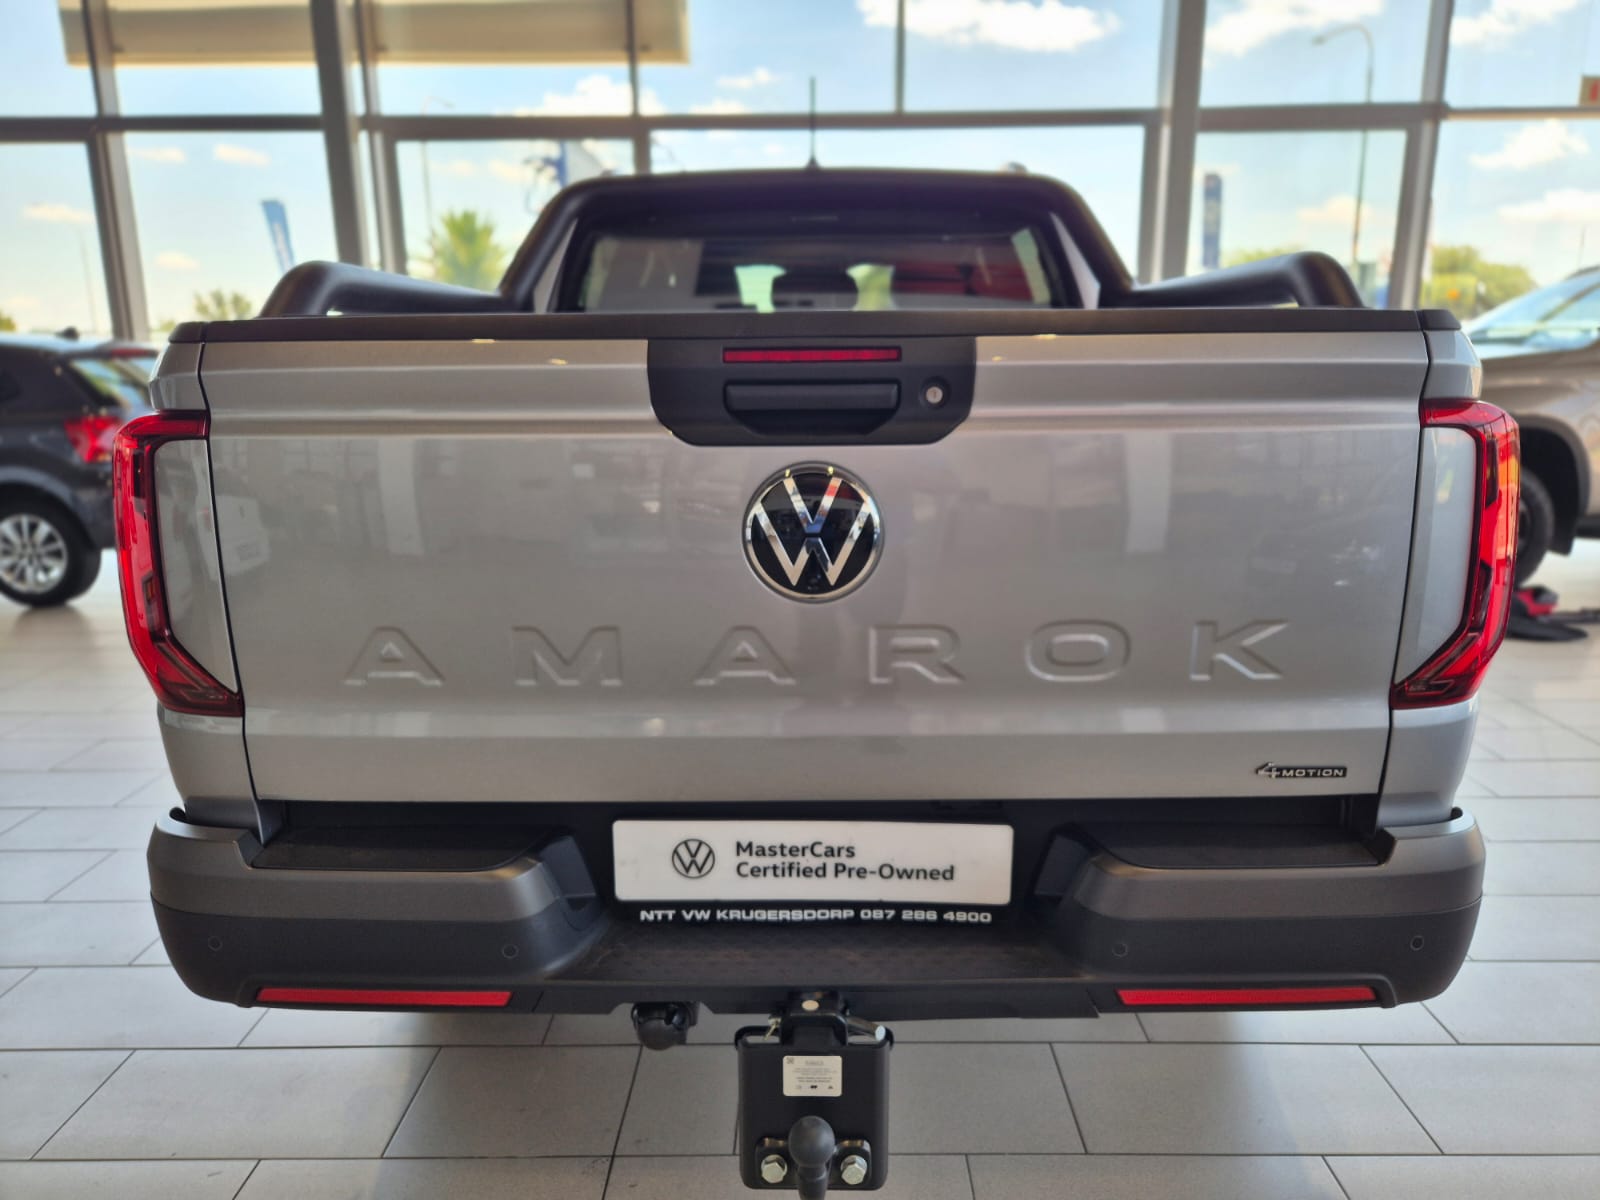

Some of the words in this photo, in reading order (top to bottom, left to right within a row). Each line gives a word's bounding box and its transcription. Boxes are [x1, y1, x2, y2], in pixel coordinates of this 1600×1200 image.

[343, 619, 1289, 687] AMAROK
[736, 841, 856, 858] MasterCars
[736, 862, 827, 878] Certified
[834, 863, 955, 881] Pre-Owned
[640, 909, 676, 921] NTT
[681, 909, 711, 921] VW
[716, 909, 855, 922] KRUGERSDORP
[860, 909, 896, 921] 087
[943, 911, 993, 923] 4900
